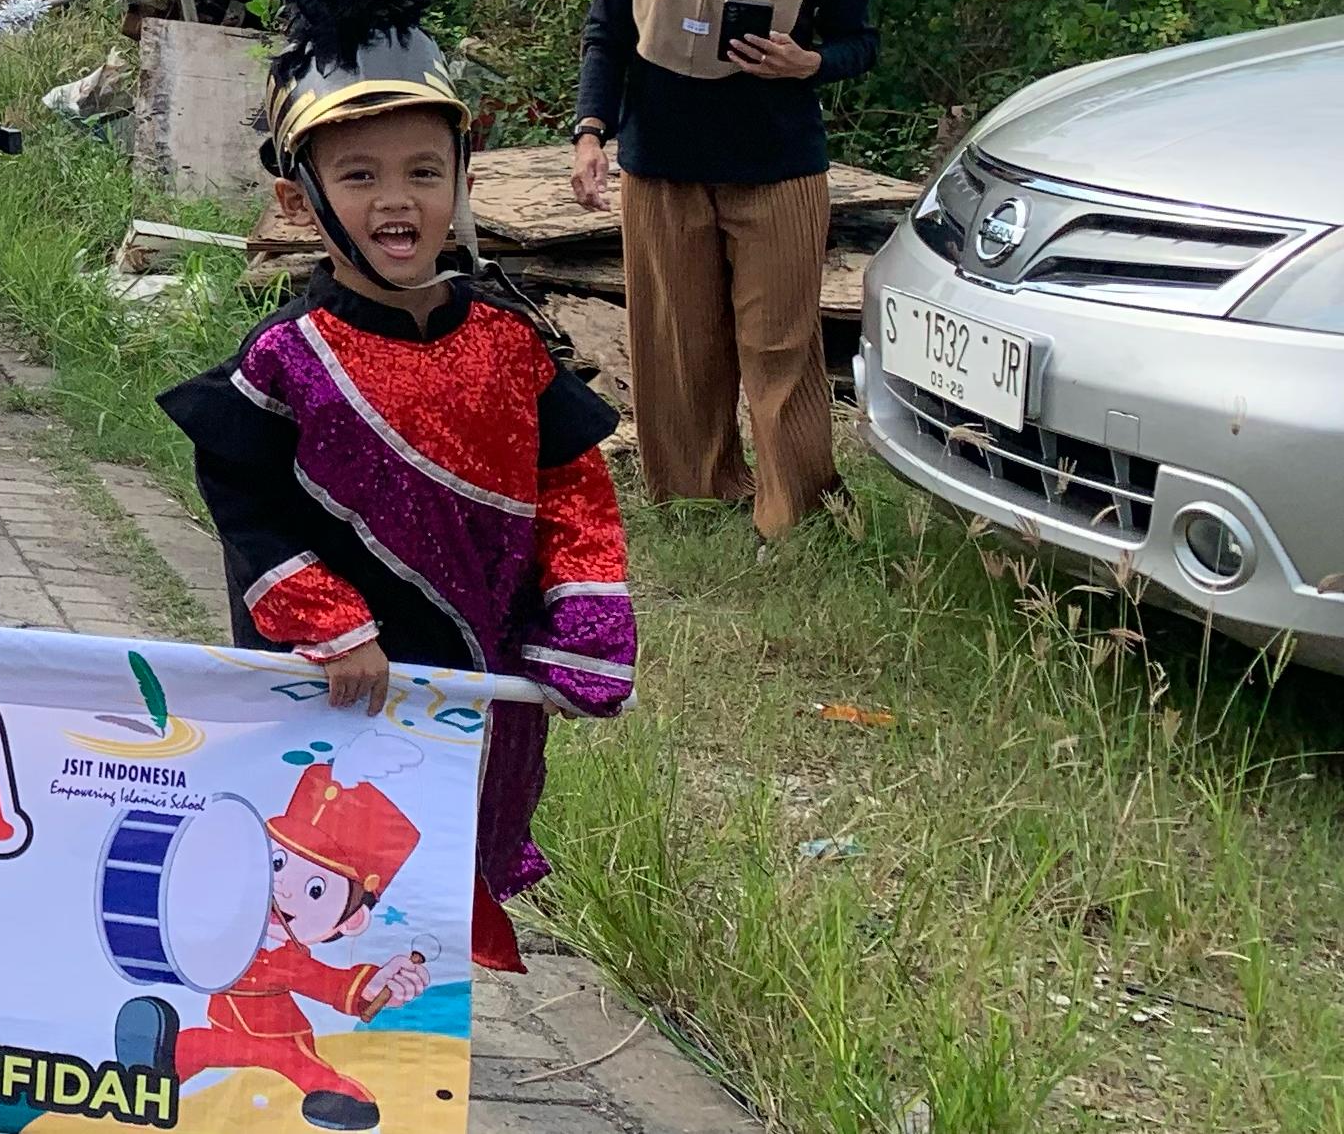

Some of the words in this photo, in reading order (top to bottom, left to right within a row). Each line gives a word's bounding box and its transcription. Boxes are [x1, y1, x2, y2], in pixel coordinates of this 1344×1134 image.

[885, 296, 898, 344] S
[924, 309, 970, 376] 1532
[992, 337, 1021, 398] JR
[61, 757, 94, 778] JSIT
[97, 761, 188, 789] INDONESIA
[49, 778, 117, 808] Empowering
[169, 792, 207, 812] School
